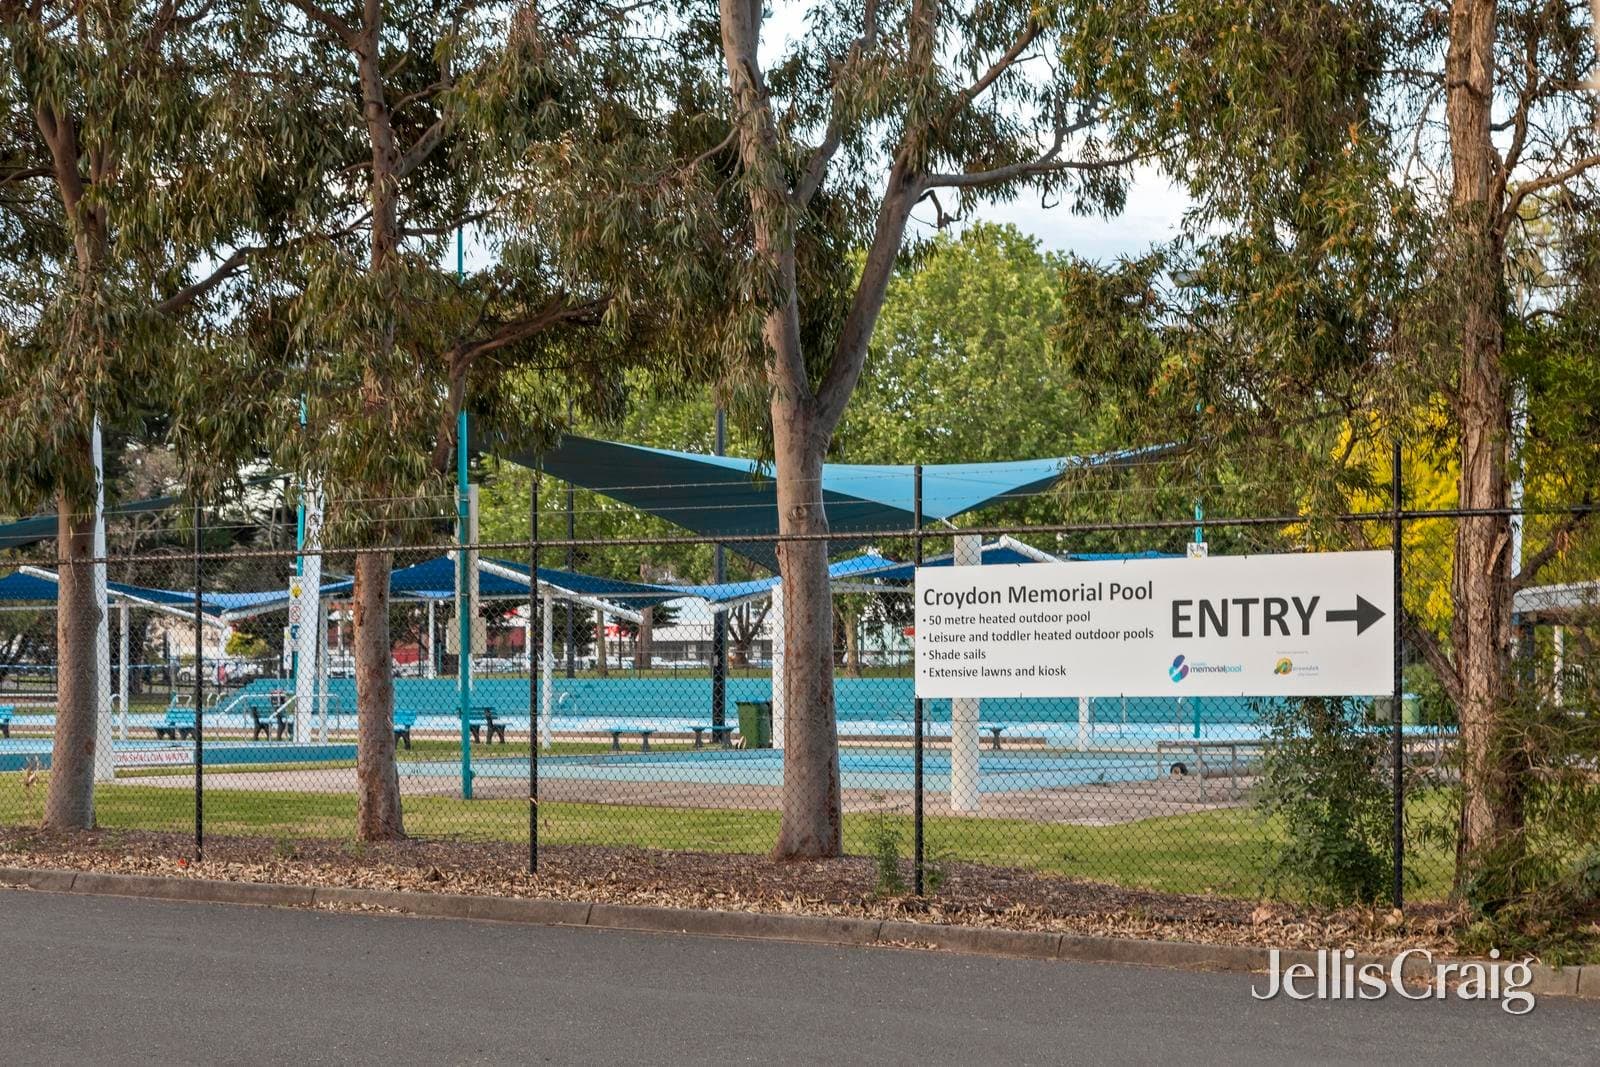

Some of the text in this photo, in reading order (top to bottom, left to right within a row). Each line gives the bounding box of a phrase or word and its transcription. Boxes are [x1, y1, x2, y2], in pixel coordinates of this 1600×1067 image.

[923, 580, 1153, 610] Croydon Memorial Pool
[929, 610, 1092, 626] 50 metre heated outdoor pool
[1171, 595, 1321, 639] ENTRY
[929, 628, 1155, 643] Leisure and toddler heated outdoor pools
[929, 648, 987, 660] Shade sails
[929, 664, 1067, 678] Extensive lawns and kiosk
